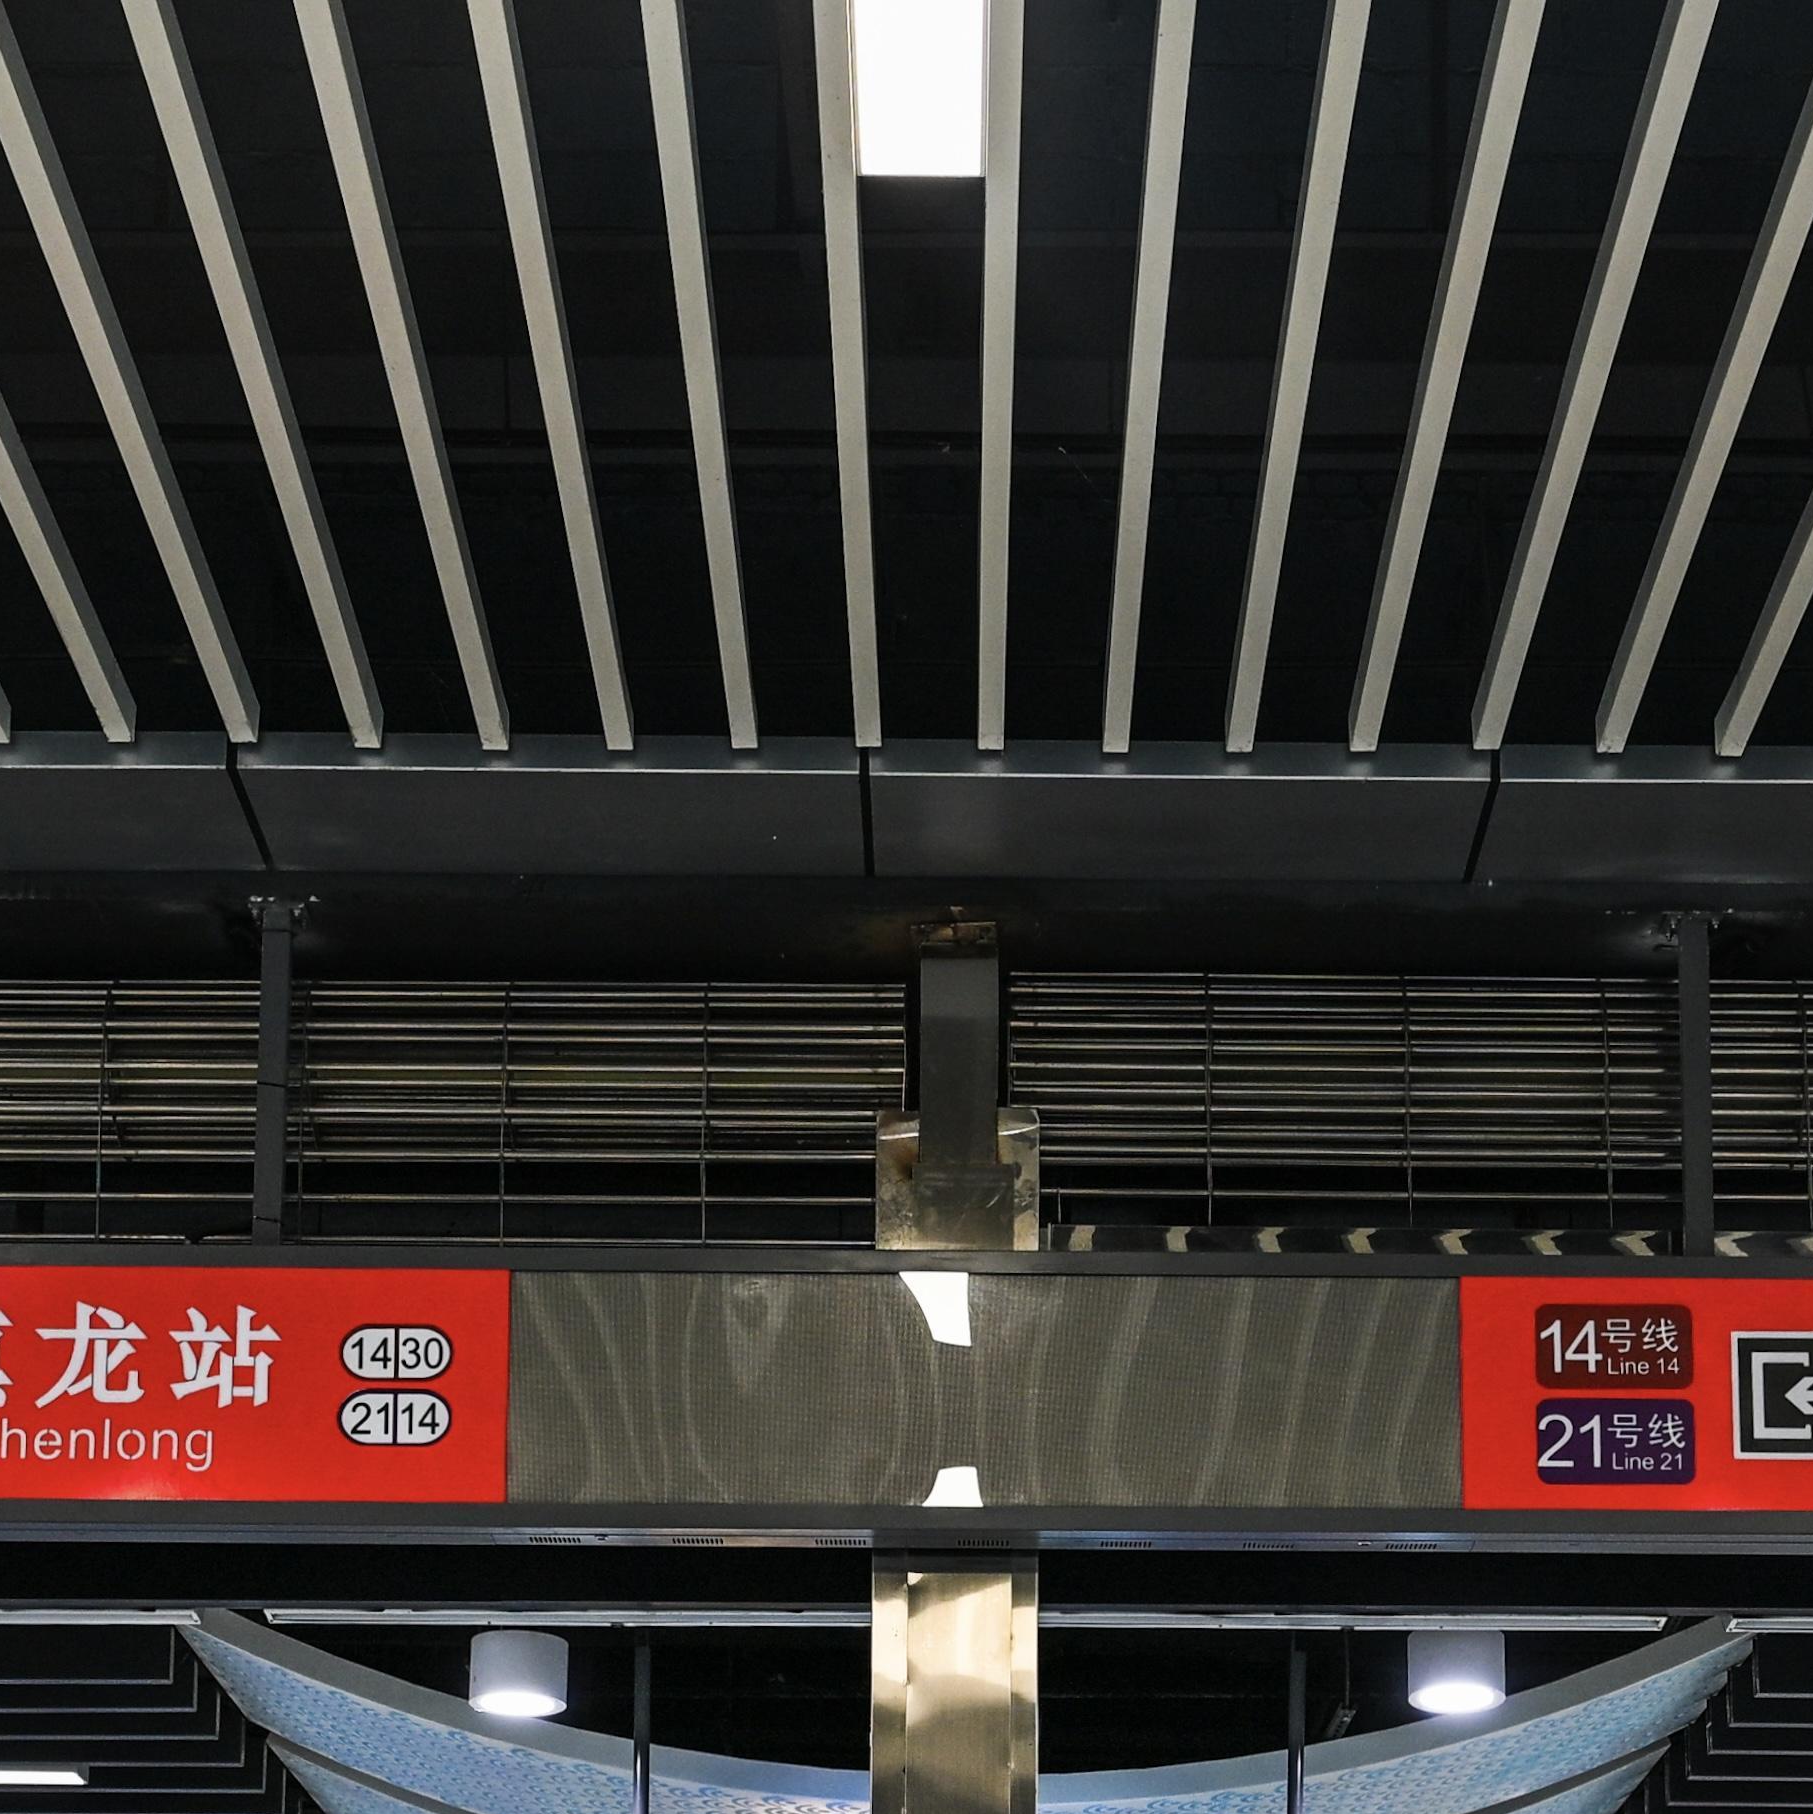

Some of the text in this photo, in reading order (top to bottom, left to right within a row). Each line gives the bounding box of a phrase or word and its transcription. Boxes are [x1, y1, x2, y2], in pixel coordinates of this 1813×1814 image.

[351, 1337, 443, 1370] 14 30
[1539, 1317, 1680, 1375] 14号线
[1607, 1357, 1680, 1375] Line 14
[350, 1402, 440, 1435] 21 14
[1537, 1413, 1686, 1470] 21号线
[1611, 1452, 1684, 1471] Line 21
